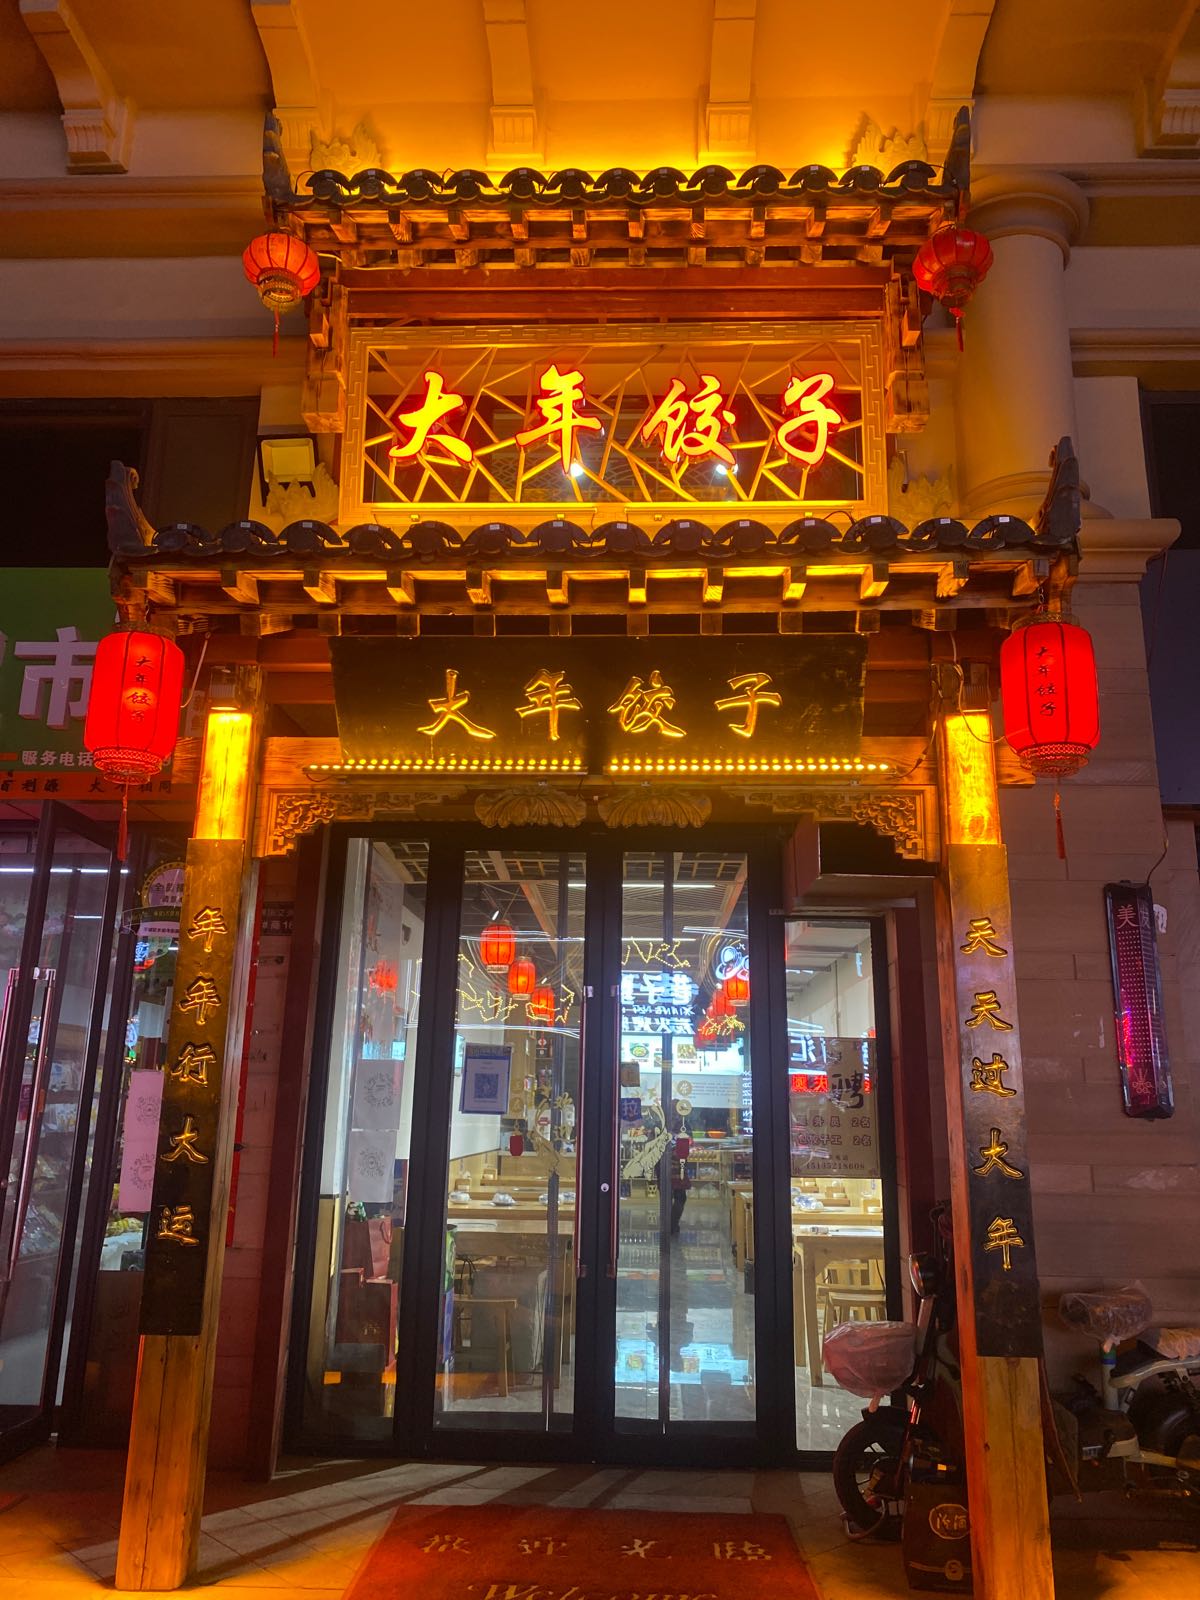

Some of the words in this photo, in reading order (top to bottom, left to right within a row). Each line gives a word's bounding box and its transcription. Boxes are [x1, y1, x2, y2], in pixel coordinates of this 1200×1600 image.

[389, 364, 842, 474] 大年饺子
[126, 655, 152, 722] 大年饺子
[416, 669, 782, 740] 大年饺子
[22, 750, 93, 767] 服务电话
[157, 904, 229, 1247] 年年行大运
[959, 916, 1025, 1272] 天天过大年
